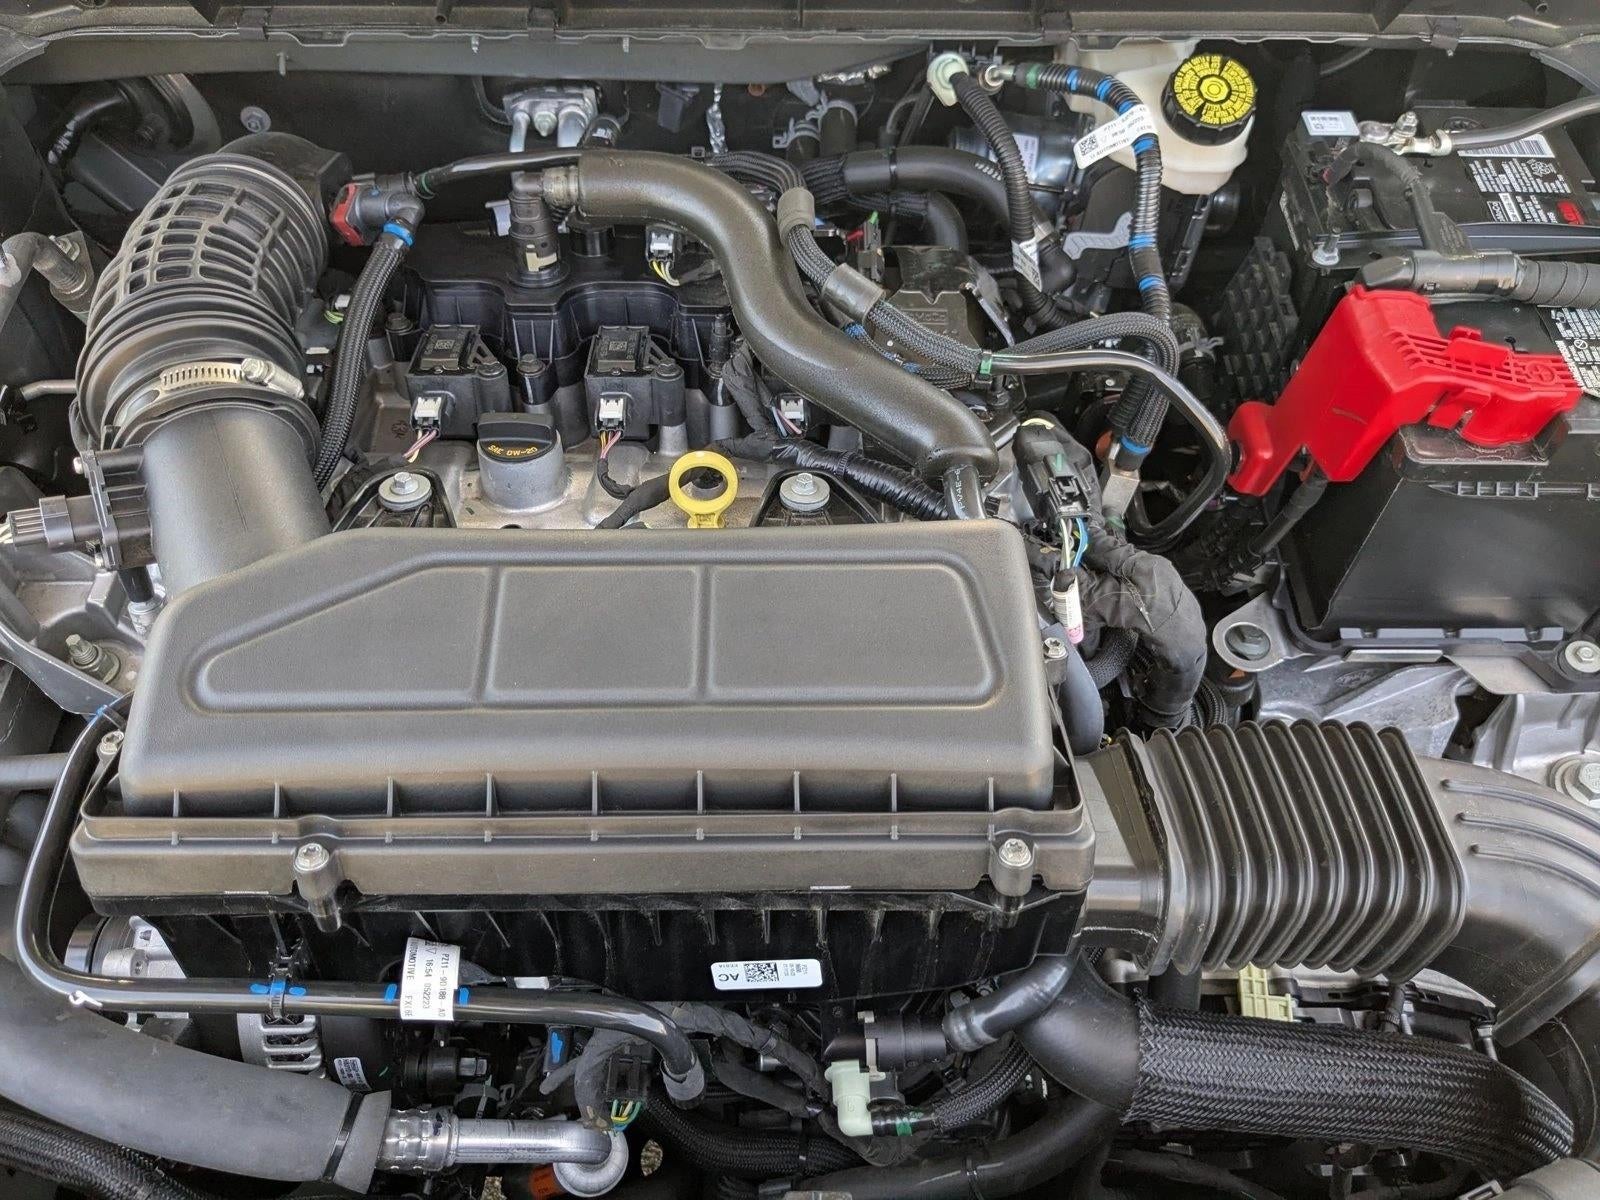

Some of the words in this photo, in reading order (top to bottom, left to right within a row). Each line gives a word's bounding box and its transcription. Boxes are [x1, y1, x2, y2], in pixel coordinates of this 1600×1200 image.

[488, 444, 504, 455] SAE
[424, 959, 434, 977] 16:54
[718, 973, 739, 982] AC
